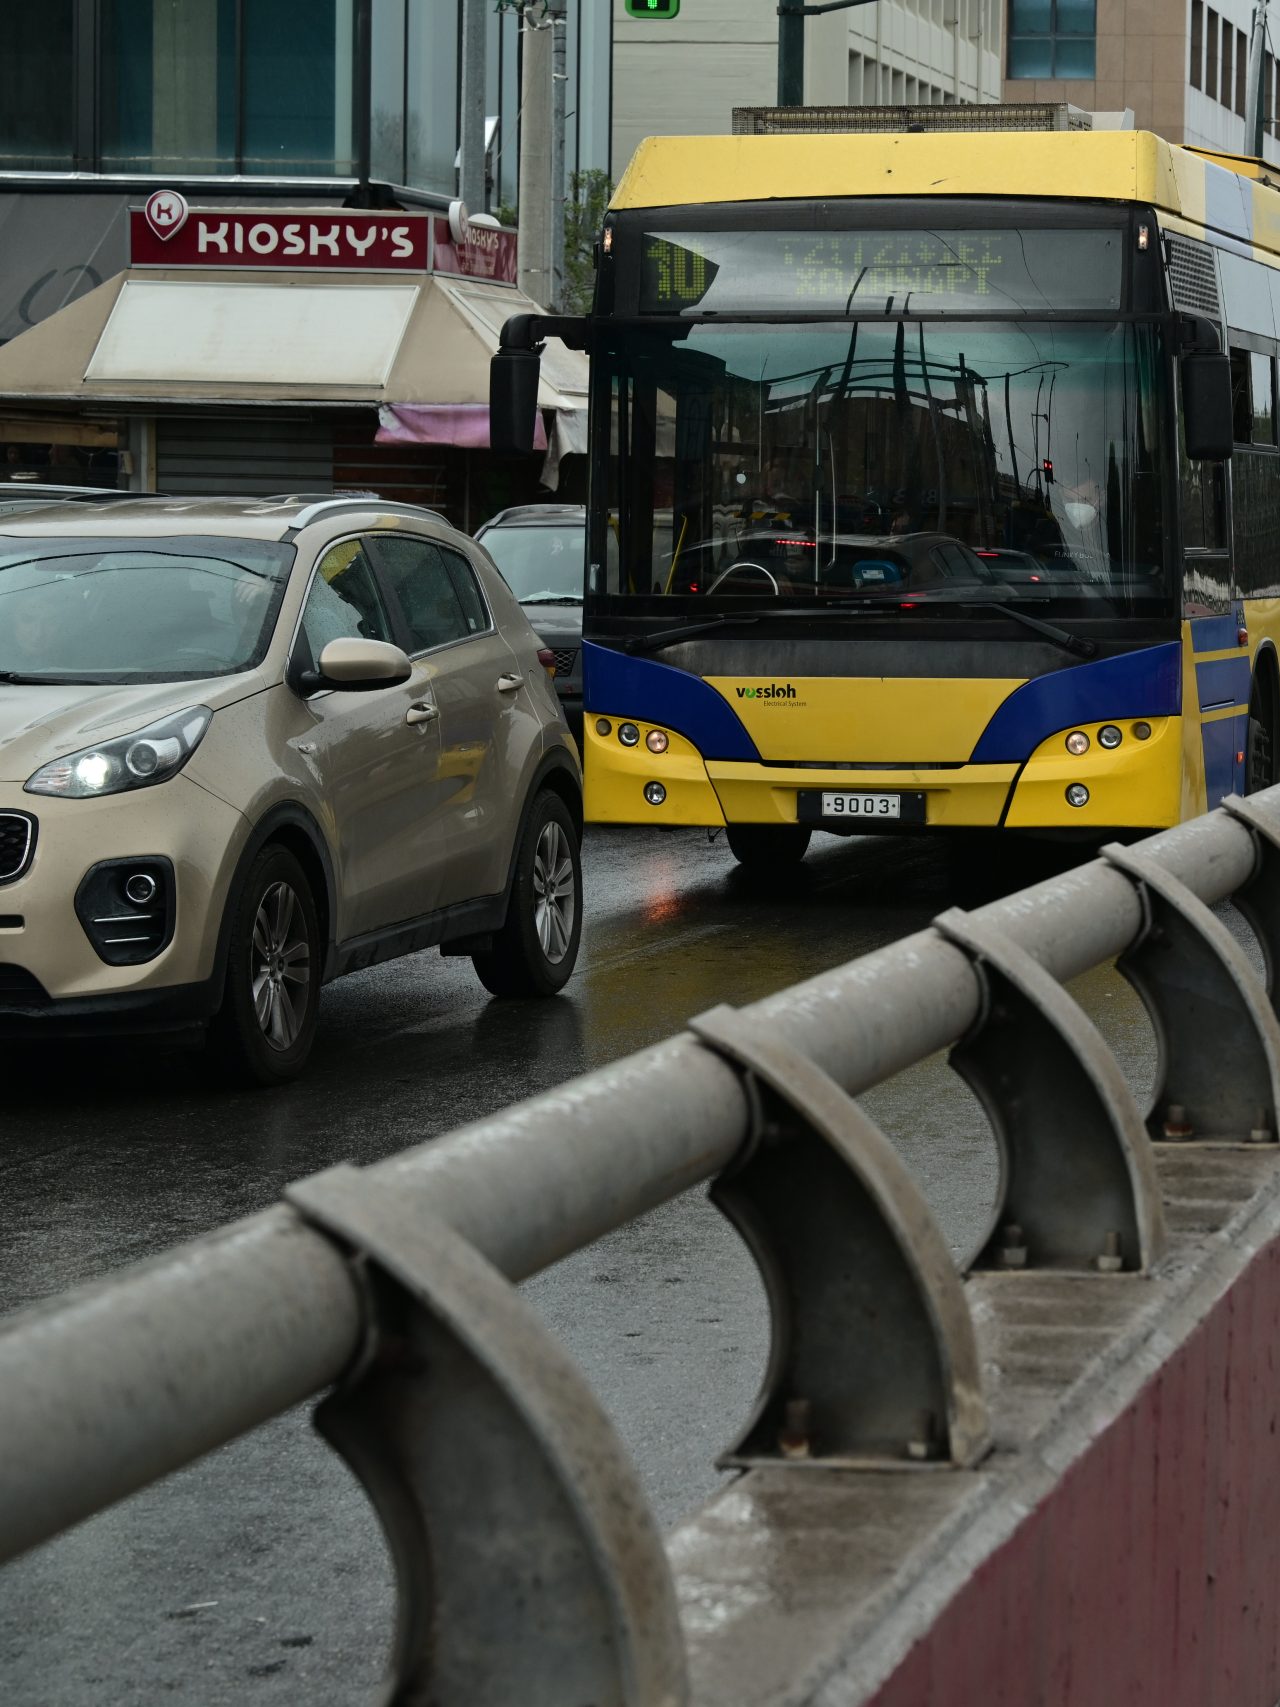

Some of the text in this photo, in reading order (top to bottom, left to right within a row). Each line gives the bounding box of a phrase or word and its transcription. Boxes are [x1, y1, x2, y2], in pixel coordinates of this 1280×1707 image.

[156, 202, 173, 220] K
[197, 221, 414, 258] KIOSKY'S
[736, 684, 797, 699] vossloh
[833, 797, 890, 814] 9003
